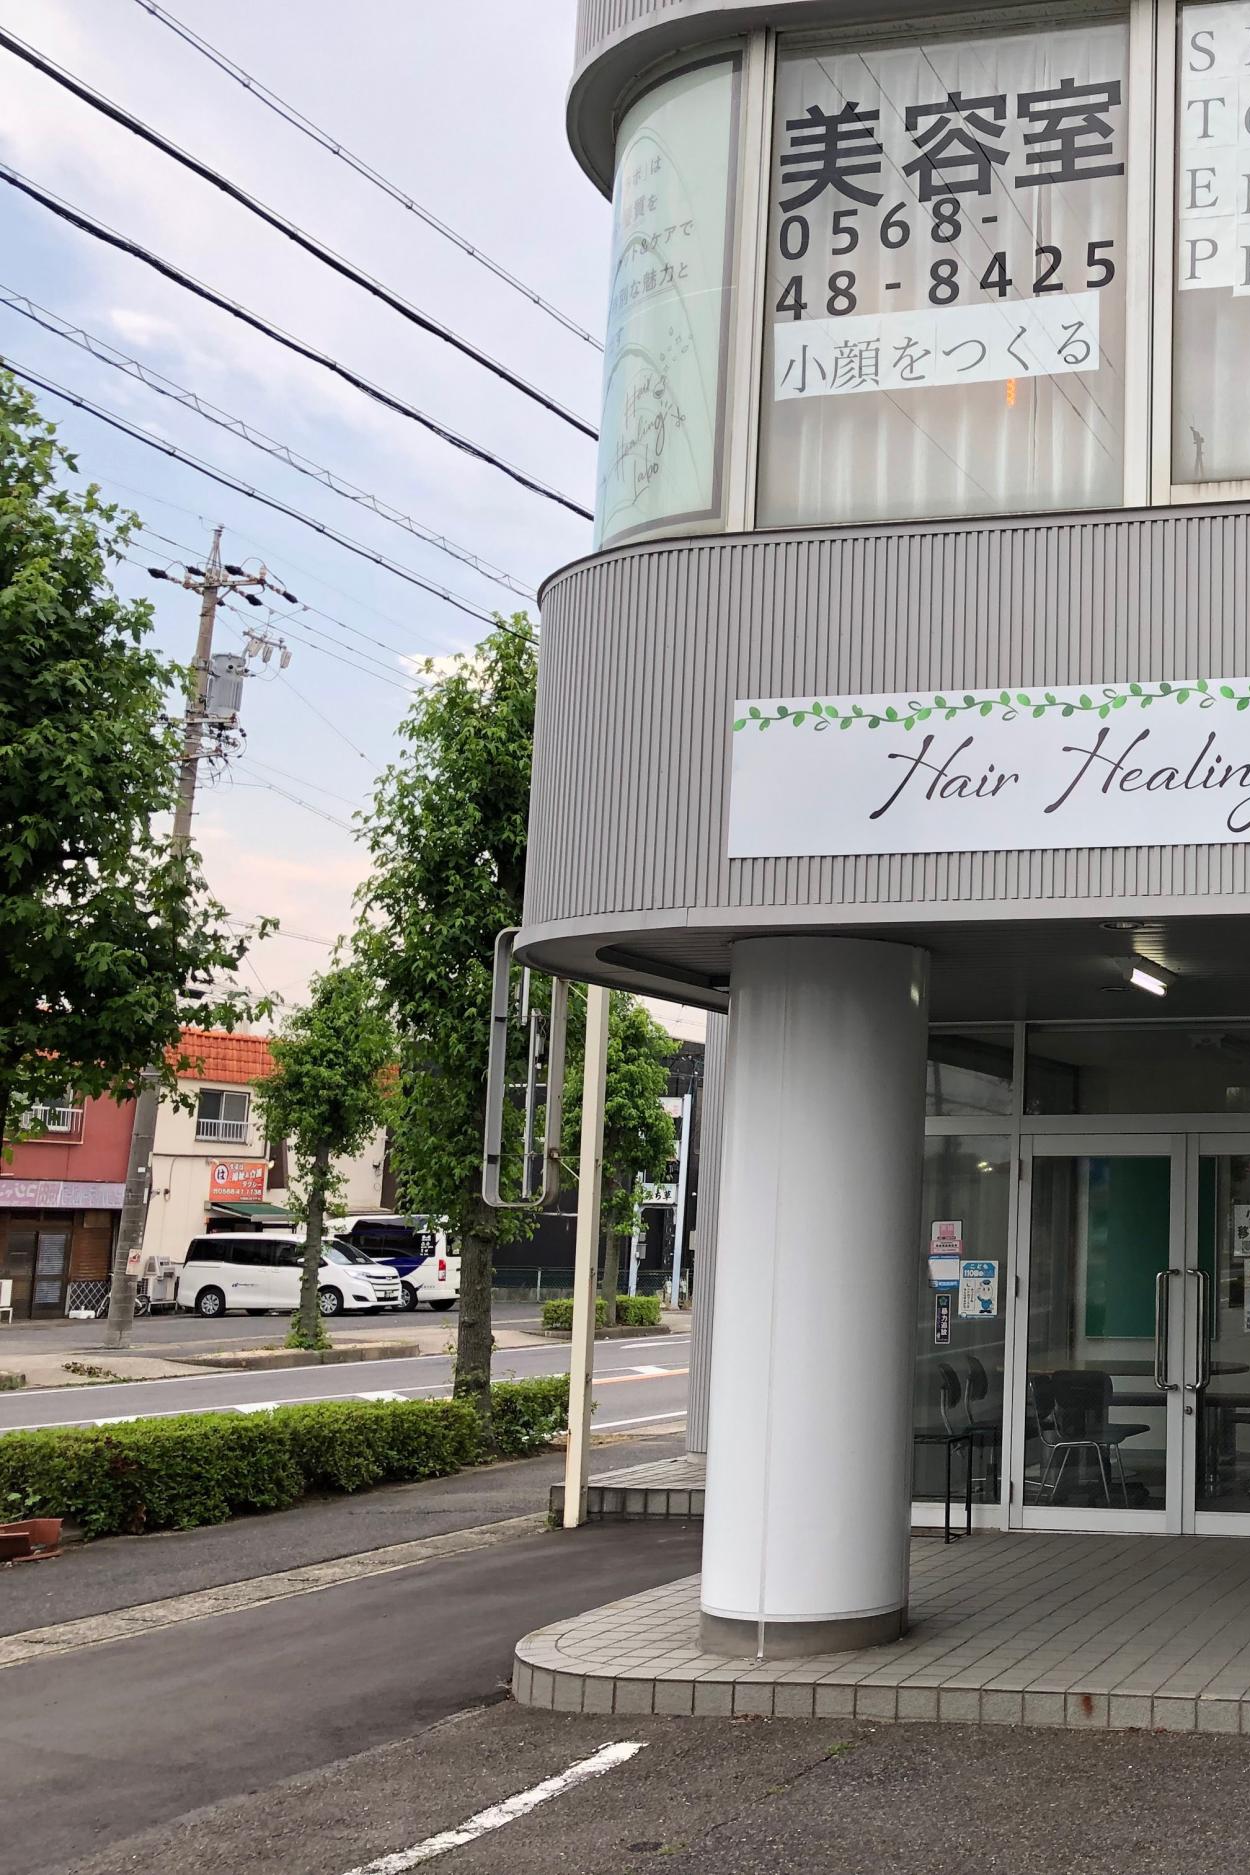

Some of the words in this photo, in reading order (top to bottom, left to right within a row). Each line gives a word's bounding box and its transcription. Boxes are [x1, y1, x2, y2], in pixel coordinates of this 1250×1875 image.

[778, 77, 1125, 214] 美容室
[775, 239, 1116, 321] 48-8425
[780, 320, 1092, 393] 小顔をつくる
[869, 734, 1020, 820] Hair
